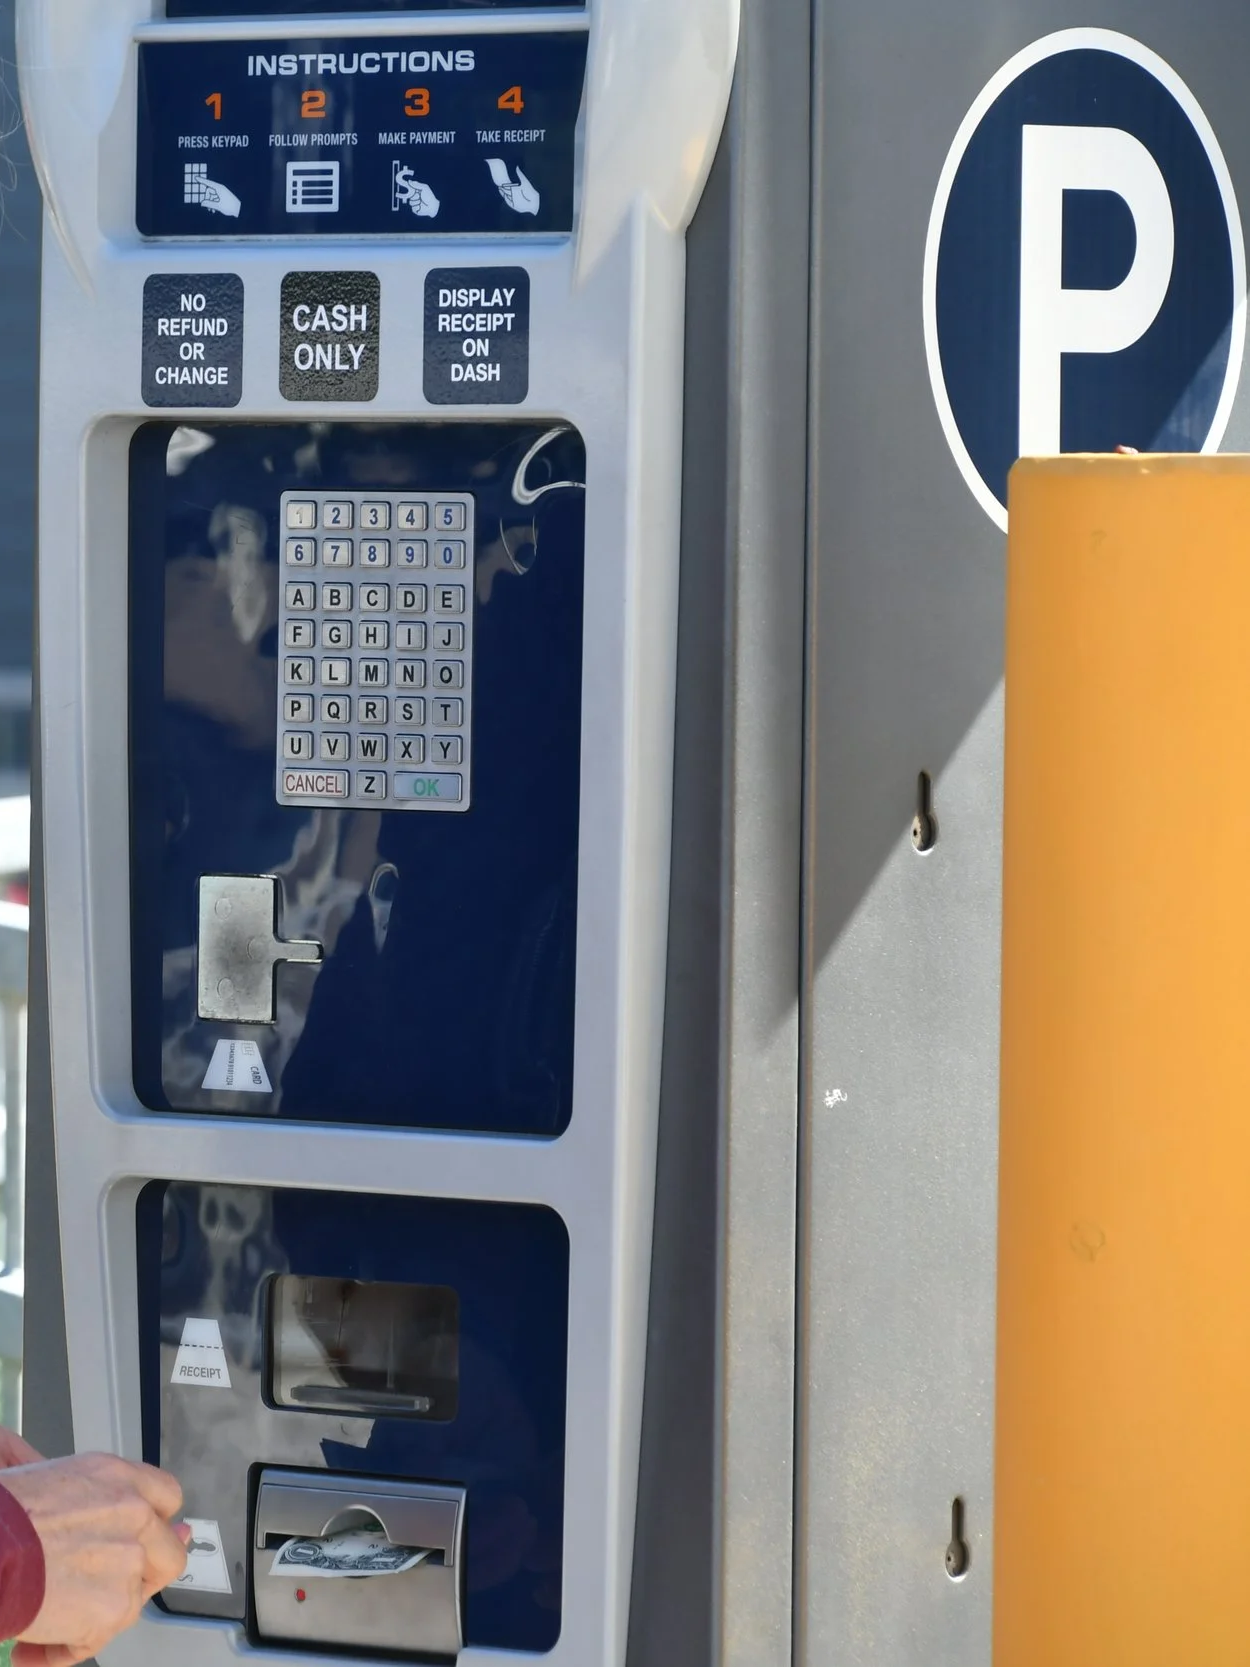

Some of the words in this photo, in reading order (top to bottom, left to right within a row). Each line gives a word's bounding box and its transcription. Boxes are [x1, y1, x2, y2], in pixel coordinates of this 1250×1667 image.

[248, 50, 474, 75] INSTRUCTIONS
[206, 93, 221, 119] 1
[302, 91, 326, 117] 2
[405, 88, 430, 116] 3
[498, 87, 523, 112] 4
[179, 136, 209, 148] PRESS
[211, 135, 248, 147] KEYPAD
[269, 134, 308, 146] FOLLOW
[311, 133, 357, 146] PROMPTS
[379, 132, 406, 144] MAKE
[410, 132, 455, 143] PAYMENT
[476, 131, 500, 142] TAKE
[504, 130, 545, 142] RECEIPT
[439, 289, 515, 307] DISPLAY
[1018, 124, 1174, 457] P
[181, 294, 205, 311] NO
[293, 304, 366, 331] CASH
[439, 314, 515, 332] RECEIPT
[158, 318, 227, 336] REFUND
[180, 343, 204, 360] OR
[294, 343, 365, 370] ONLY
[463, 339, 488, 357] ON
[156, 367, 228, 384] CHANGE
[451, 363, 500, 381] DASH
[332, 507, 340, 524] 2
[370, 508, 378, 525] 3
[406, 509, 415, 525] 4
[444, 509, 452, 525] 5
[295, 545, 303, 561] 6
[331, 546, 340, 562] 7
[368, 546, 376, 562] 8
[406, 546, 414, 563] 9
[444, 547, 452, 563] 0
[293, 589, 304, 605] A
[330, 589, 340, 605] B
[367, 590, 377, 606] C
[404, 591, 415, 607] D
[442, 591, 452, 608] E
[293, 626, 302, 642] F
[329, 627, 341, 643] G
[366, 627, 376, 643] H
[408, 628, 411, 645] I
[443, 629, 451, 646] J
[291, 663, 302, 680] K
[329, 664, 338, 680] L
[365, 665, 378, 681] M
[403, 665, 414, 682] N
[440, 666, 452, 683] O
[291, 700, 301, 717] P
[328, 702, 340, 719] Q
[366, 702, 376, 718] R
[403, 703, 413, 720] S
[441, 704, 450, 721] T
[291, 738, 301, 754] U
[327, 739, 338, 755] V
[361, 740, 377, 756] W
[402, 741, 412, 758] X
[440, 742, 450, 759] Y
[286, 775, 342, 793] CANCEL
[365, 776, 375, 793] Z
[414, 779, 438, 796] OK
[250, 1066, 262, 1084] CARD
[179, 1365, 221, 1379] RECEIPT
